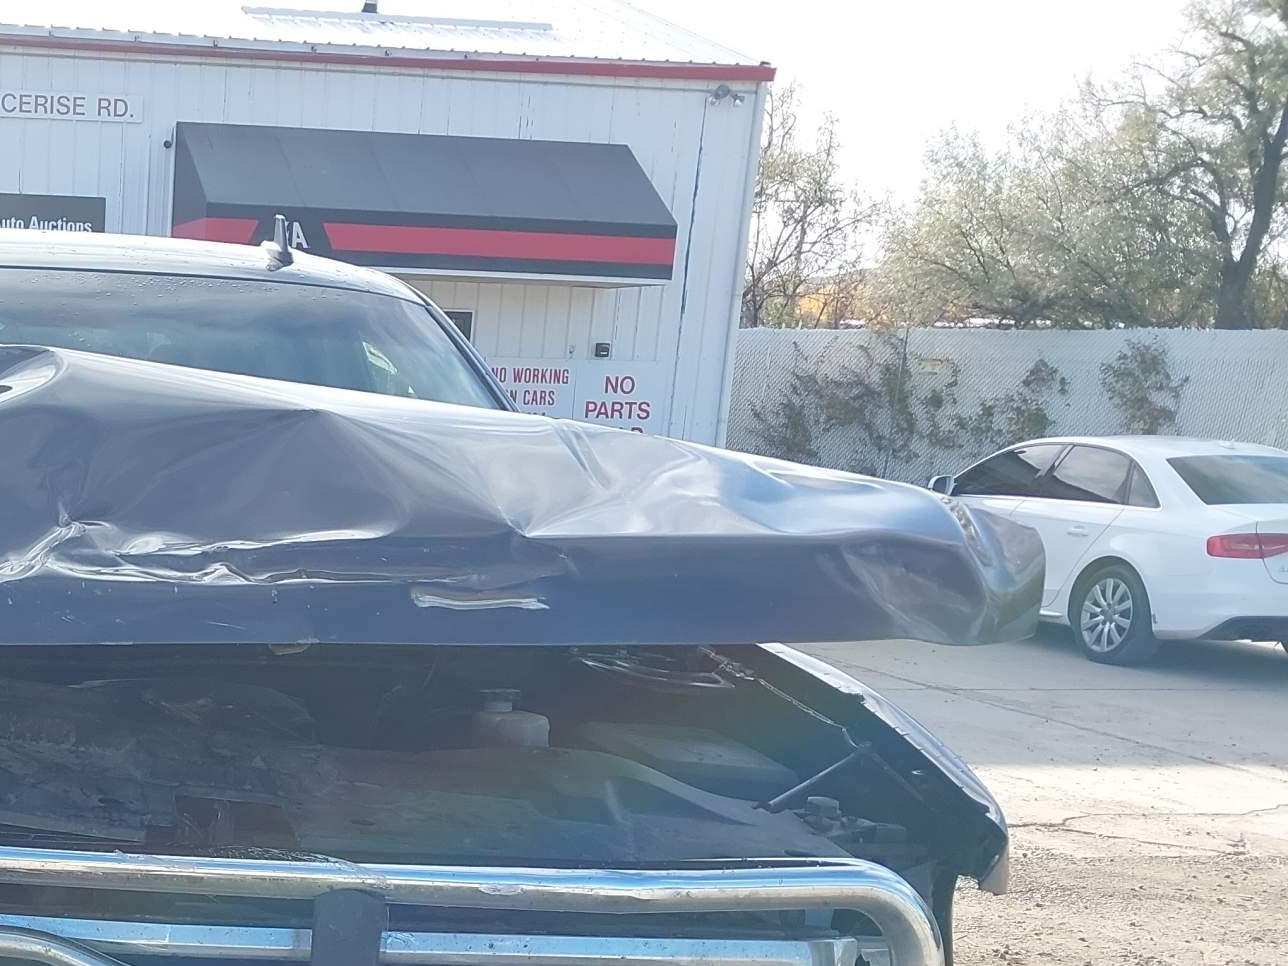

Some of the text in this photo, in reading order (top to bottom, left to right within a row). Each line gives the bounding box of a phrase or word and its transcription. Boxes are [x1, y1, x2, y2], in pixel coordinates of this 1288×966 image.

[1, 93, 86, 116] CERISE
[97, 98, 134, 118] RD.
[29, 216, 93, 232] Auctions
[513, 367, 569, 385] WORKING
[604, 375, 635, 395] NO
[523, 389, 555, 406] CARS
[584, 400, 651, 420] PARTS
